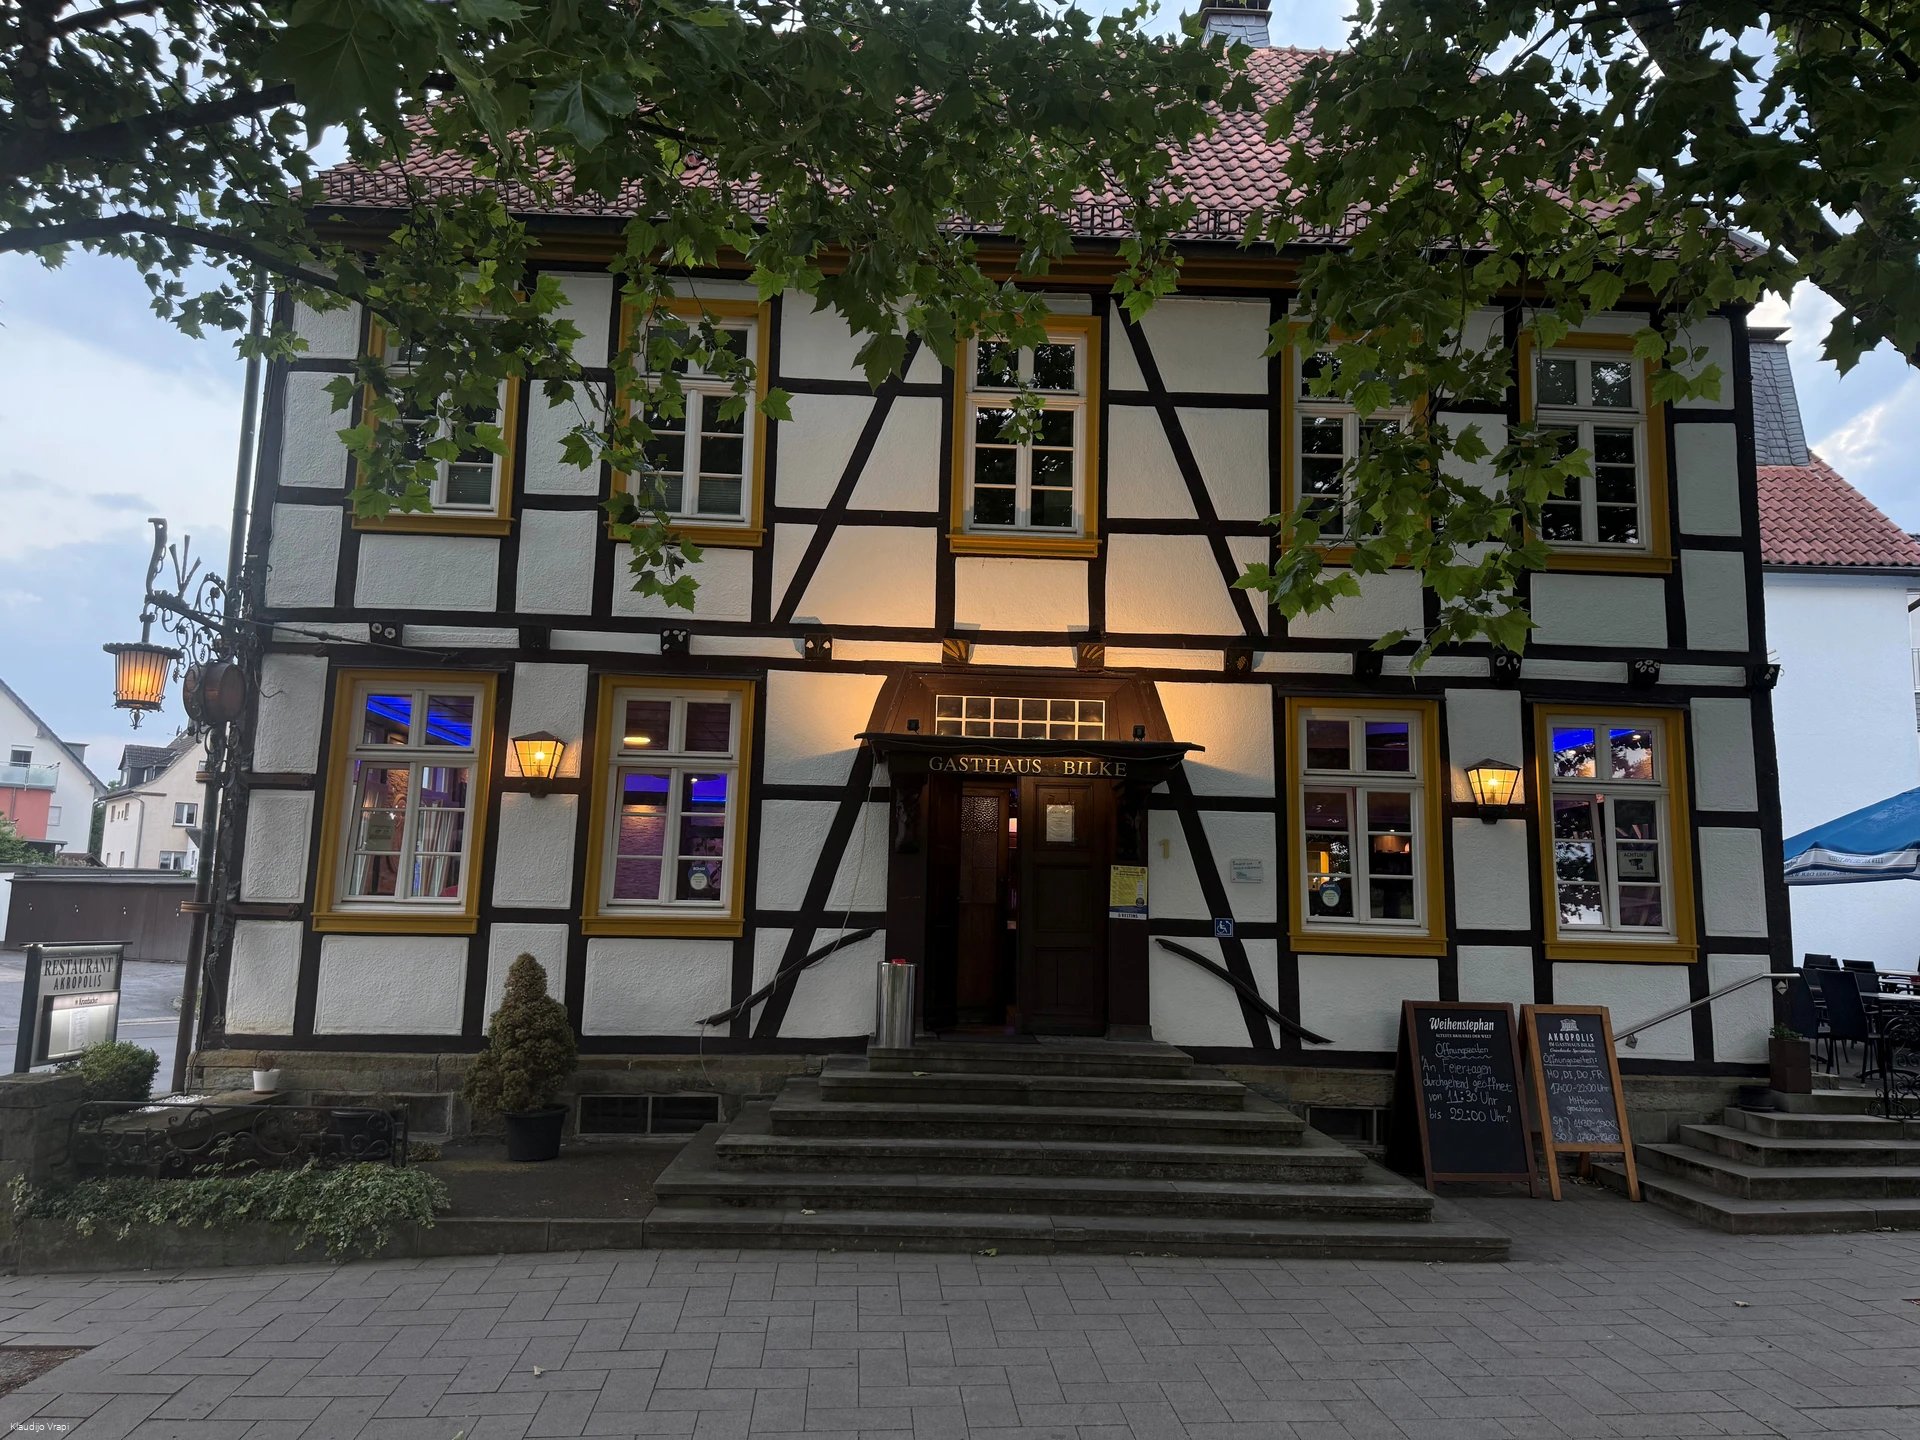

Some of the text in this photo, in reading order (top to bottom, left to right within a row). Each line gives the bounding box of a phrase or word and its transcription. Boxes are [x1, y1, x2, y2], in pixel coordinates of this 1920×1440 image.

[928, 756, 1127, 777] GASTHAUS BILKE
[1159, 839, 1170, 859] 1
[43, 957, 114, 977] RESTAURANT
[53, 974, 102, 991] AKROPOLIS
[1428, 1017, 1494, 1033] Weihenstephan
[1548, 1032, 1594, 1042] AKROPOLIS
[1442, 1058, 1492, 1079] Feiertagen
[1423, 1072, 1469, 1090] durchgehend
[1428, 1090, 1498, 1105] von 11:30 Uhr
[1568, 1095, 1600, 1105] Mittwoch
[1429, 1107, 1442, 1120] bis
[1449, 1107, 1486, 1122] 22:00
